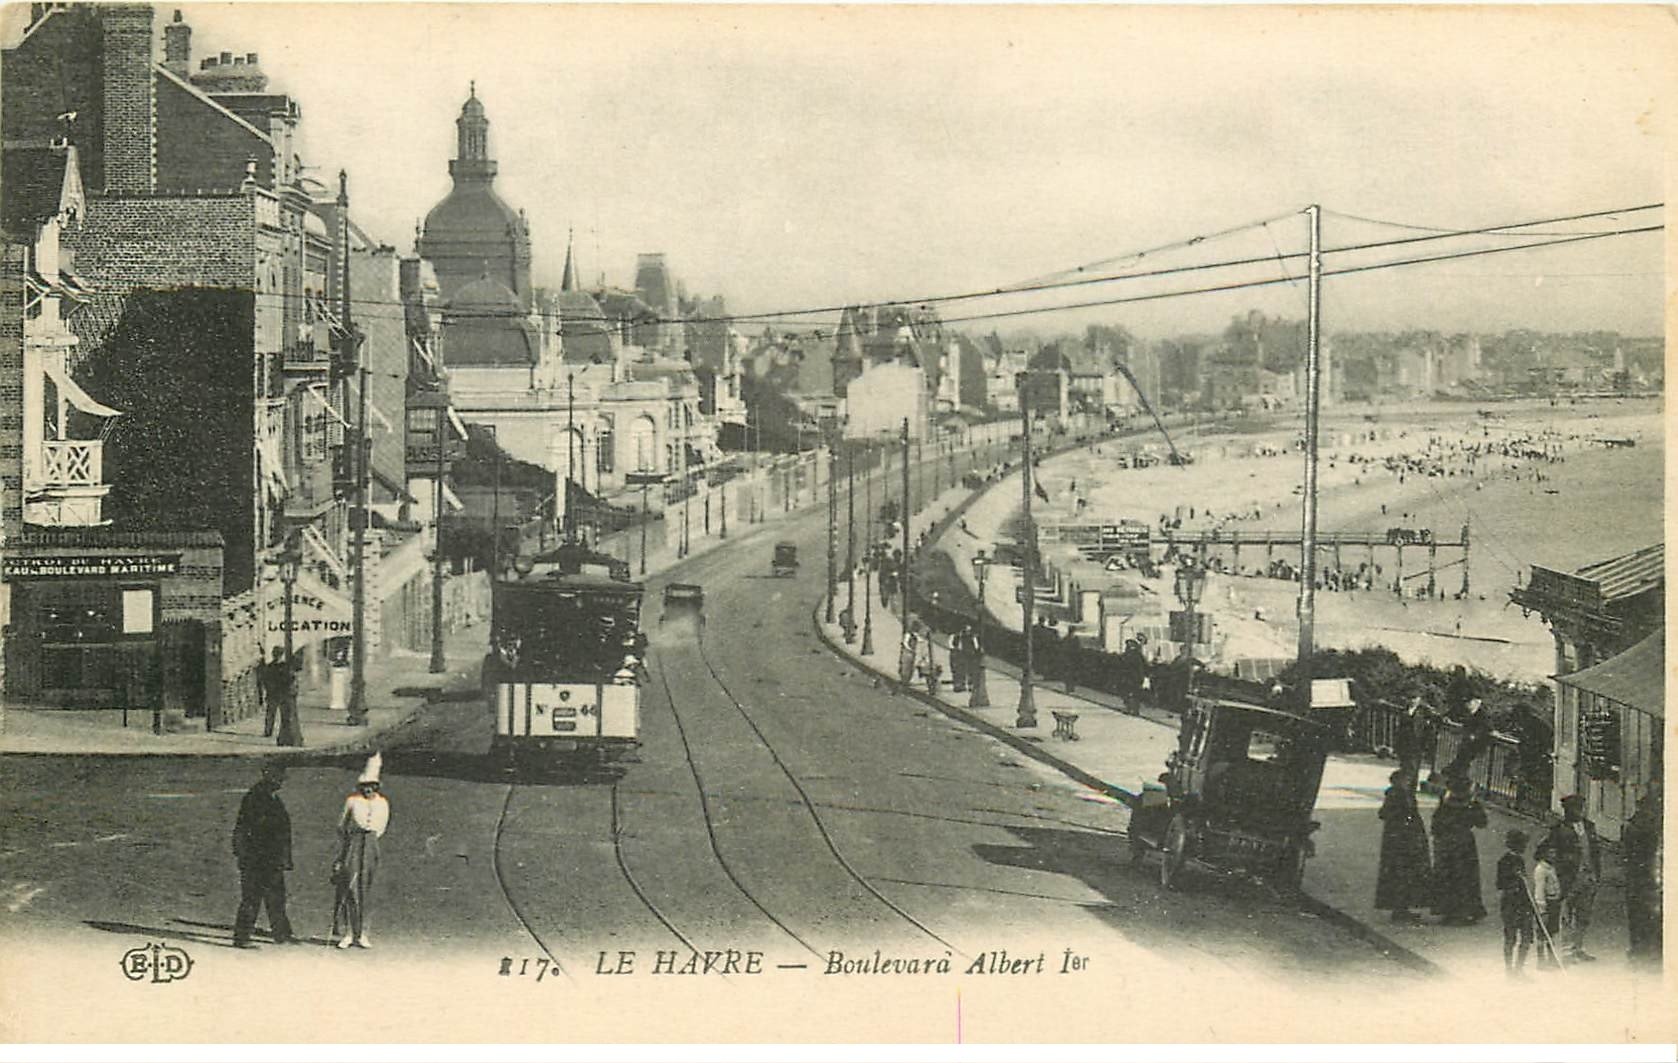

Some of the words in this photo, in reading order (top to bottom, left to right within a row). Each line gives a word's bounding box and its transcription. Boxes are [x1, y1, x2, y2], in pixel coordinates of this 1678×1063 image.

[39, 565, 106, 576] BOULEVARD
[110, 563, 175, 575] MARITIME
[268, 620, 351, 632] LOCATION
